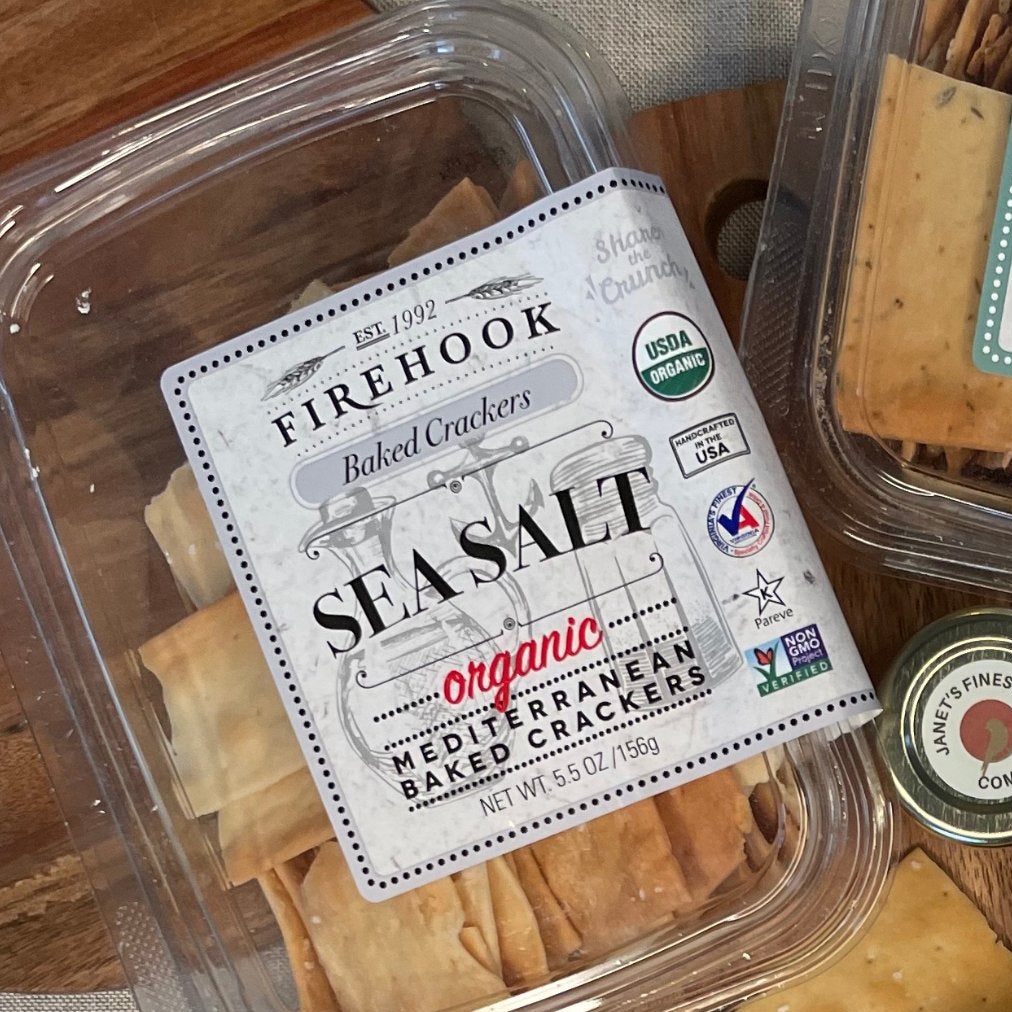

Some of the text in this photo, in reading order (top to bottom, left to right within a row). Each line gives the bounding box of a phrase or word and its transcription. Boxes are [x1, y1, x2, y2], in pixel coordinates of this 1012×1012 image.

[595, 225, 664, 264] Share
[628, 249, 651, 266] the
[352, 299, 437, 345] EST. 1992
[645, 330, 692, 361] USDA
[271, 302, 560, 447] FIREHOOK
[650, 353, 706, 384] ORGANIC
[342, 388, 531, 485] Baked Crackers
[675, 418, 735, 447] HANDCRAFTED
[695, 433, 722, 449] IN THE
[695, 442, 730, 464] USA
[313, 548, 464, 659] SEA
[459, 467, 652, 588] SALT
[760, 586, 773, 600] K
[754, 608, 794, 629] Pareve
[785, 627, 817, 648] NON
[789, 638, 820, 657] GMO
[443, 617, 603, 713] organic
[793, 650, 823, 666] Project
[761, 662, 829, 693] VERIFIED
[391, 640, 696, 774] MEDITERRANEAN
[932, 686, 962, 756] JANET'S
[400, 666, 706, 801] BAKED CRACKERS
[479, 735, 661, 817] NET WT. 5.5 OZ /156g
